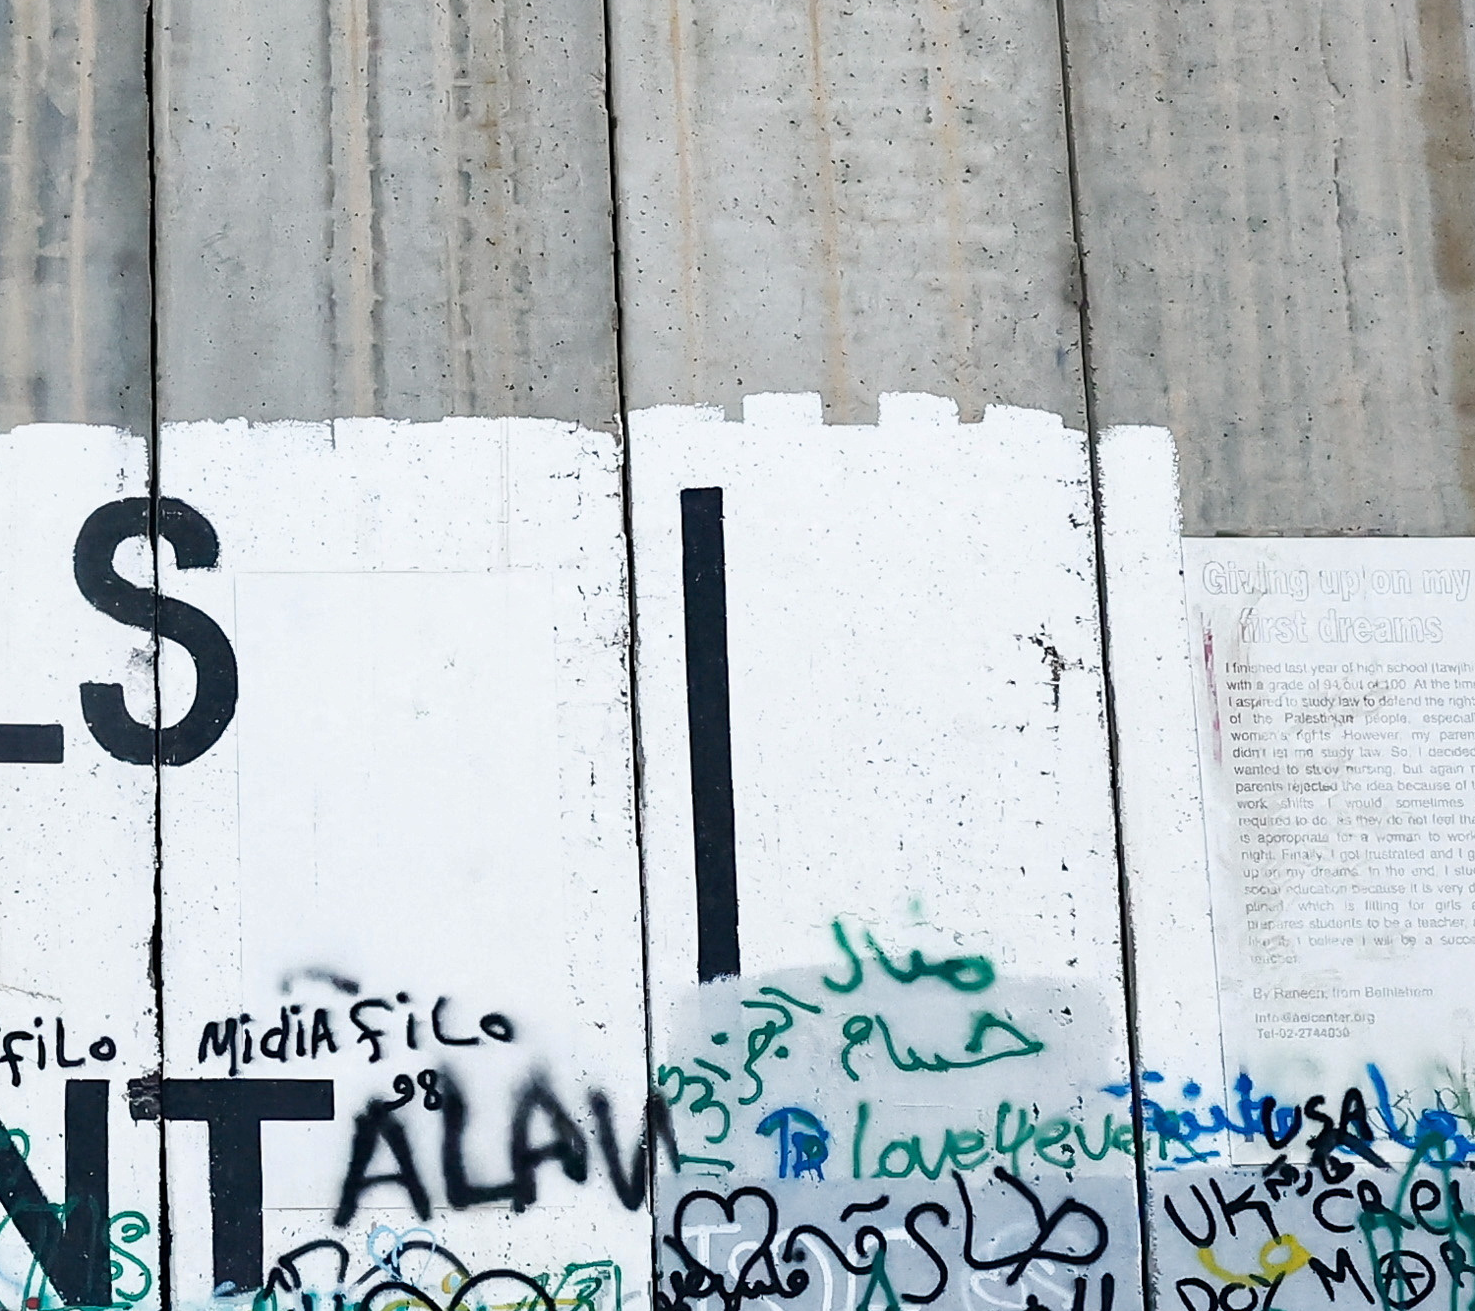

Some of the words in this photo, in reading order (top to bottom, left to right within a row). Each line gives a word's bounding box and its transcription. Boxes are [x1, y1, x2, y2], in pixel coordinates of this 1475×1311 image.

[1202, 560, 1309, 601] Giving
[1319, 569, 1360, 601] up
[1371, 569, 1411, 595] on
[1422, 568, 1470, 601] my
[1238, 607, 1307, 644] first
[1318, 608, 1444, 644] dreams
[1261, 1087, 1373, 1150] USA
